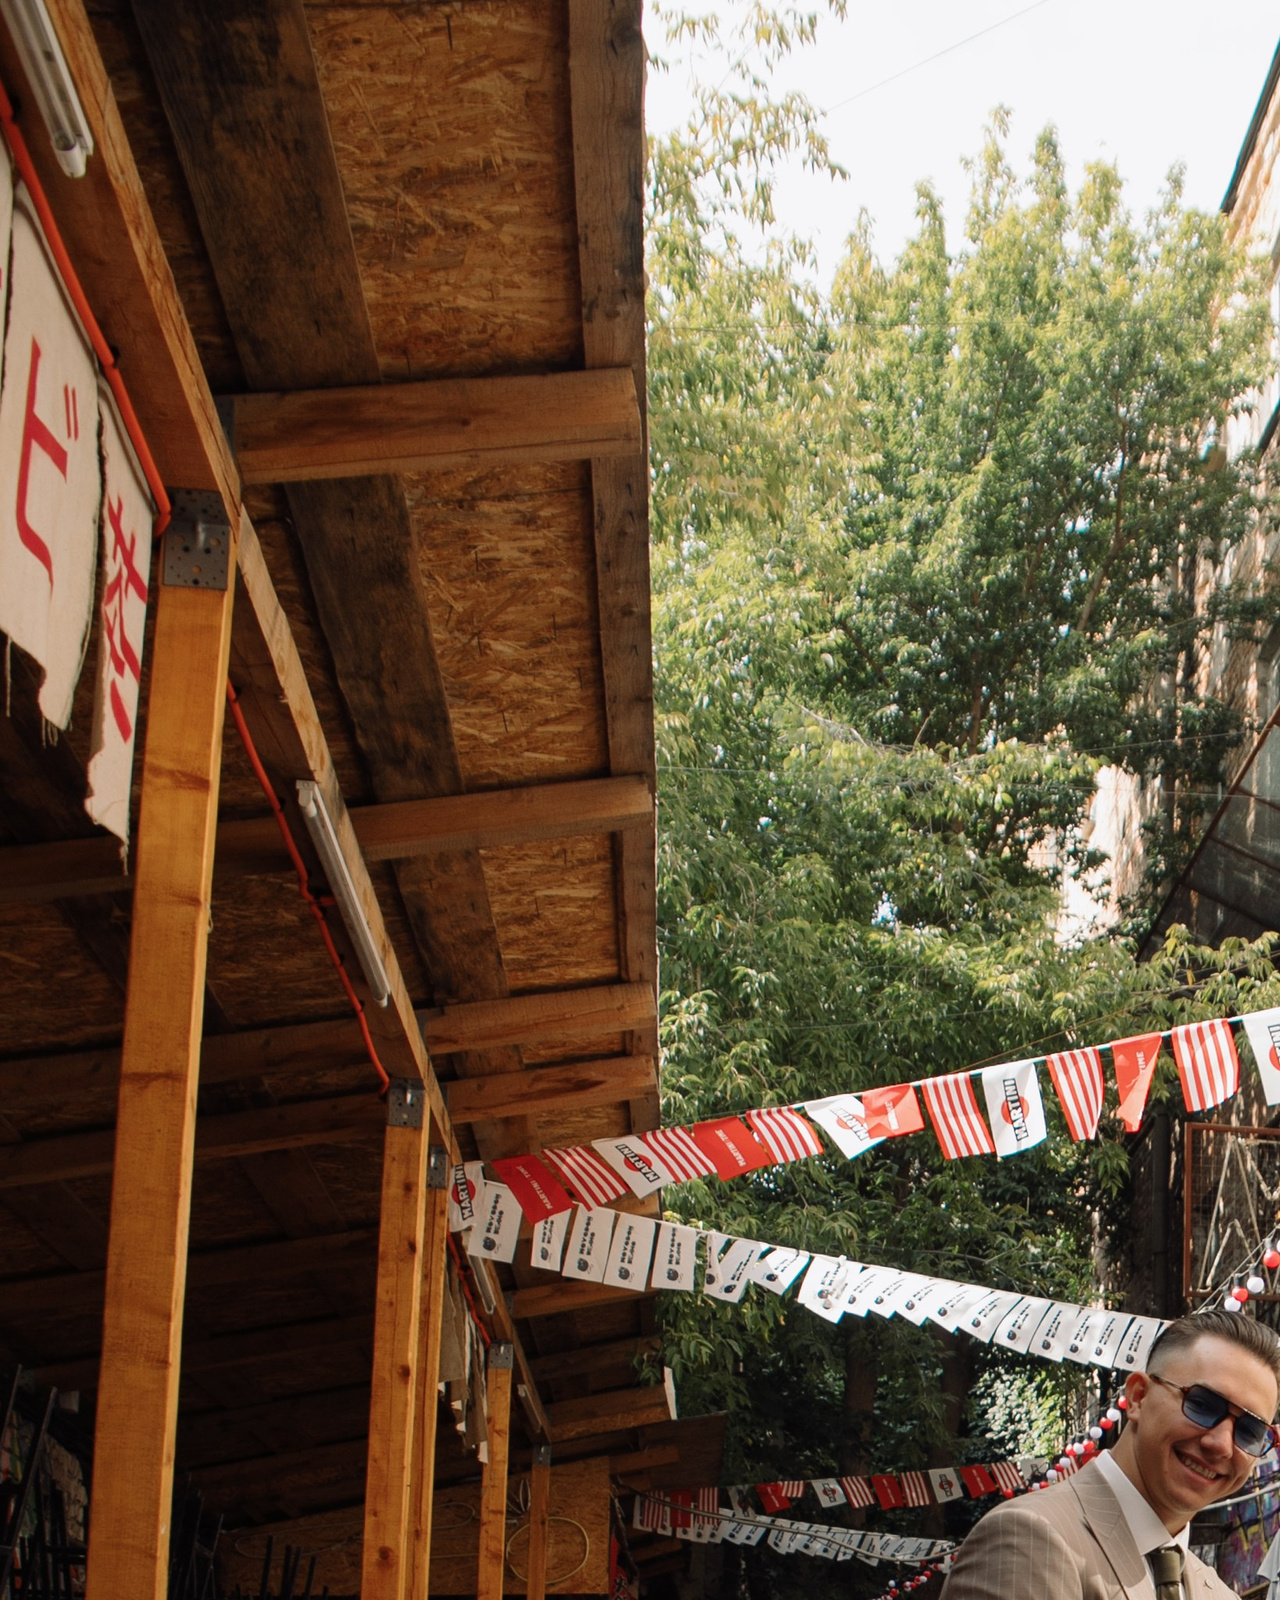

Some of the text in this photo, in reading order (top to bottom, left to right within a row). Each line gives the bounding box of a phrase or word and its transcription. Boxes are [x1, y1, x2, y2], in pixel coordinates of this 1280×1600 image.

[1003, 1077, 1029, 1142] MARTINI
[615, 1143, 661, 1183] MARTINI
[724, 1137, 747, 1167] MARTINI
[515, 1164, 532, 1180] TIME
[454, 1163, 474, 1221] MARTINI
[530, 1180, 554, 1210] MARTINI
